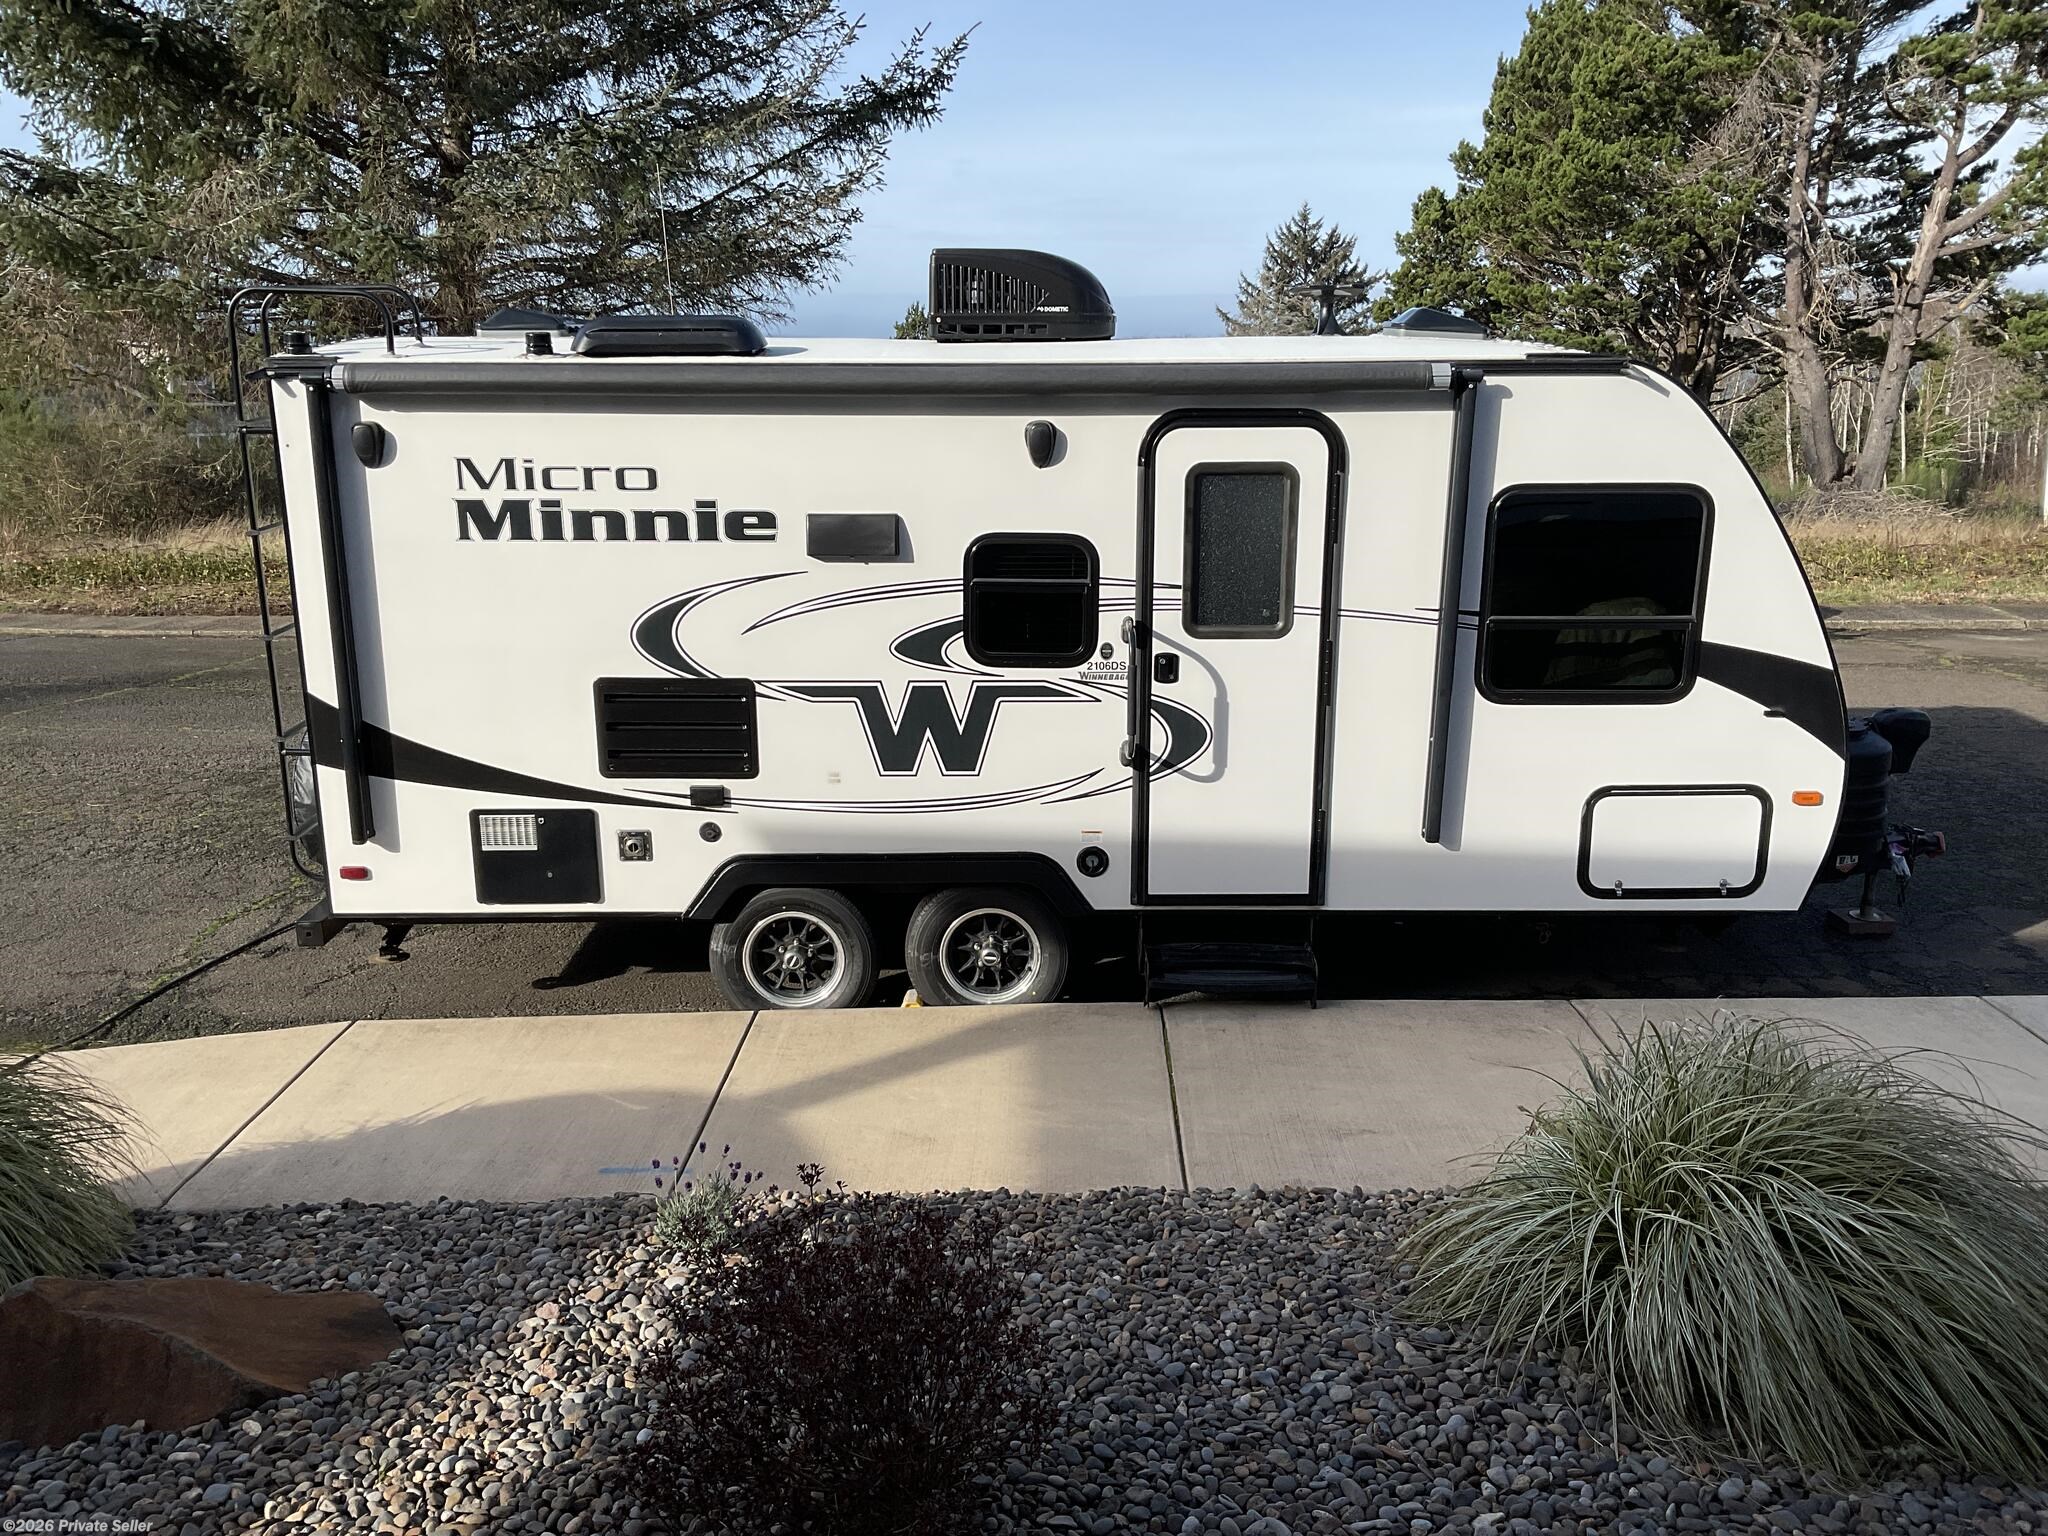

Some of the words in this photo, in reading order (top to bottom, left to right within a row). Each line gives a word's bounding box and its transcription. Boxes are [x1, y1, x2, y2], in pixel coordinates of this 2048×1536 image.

[454, 456, 658, 491] Micro
[451, 497, 778, 543] Minnie
[1087, 661, 1127, 671] 2106DS
[854, 680, 1002, 777] W
